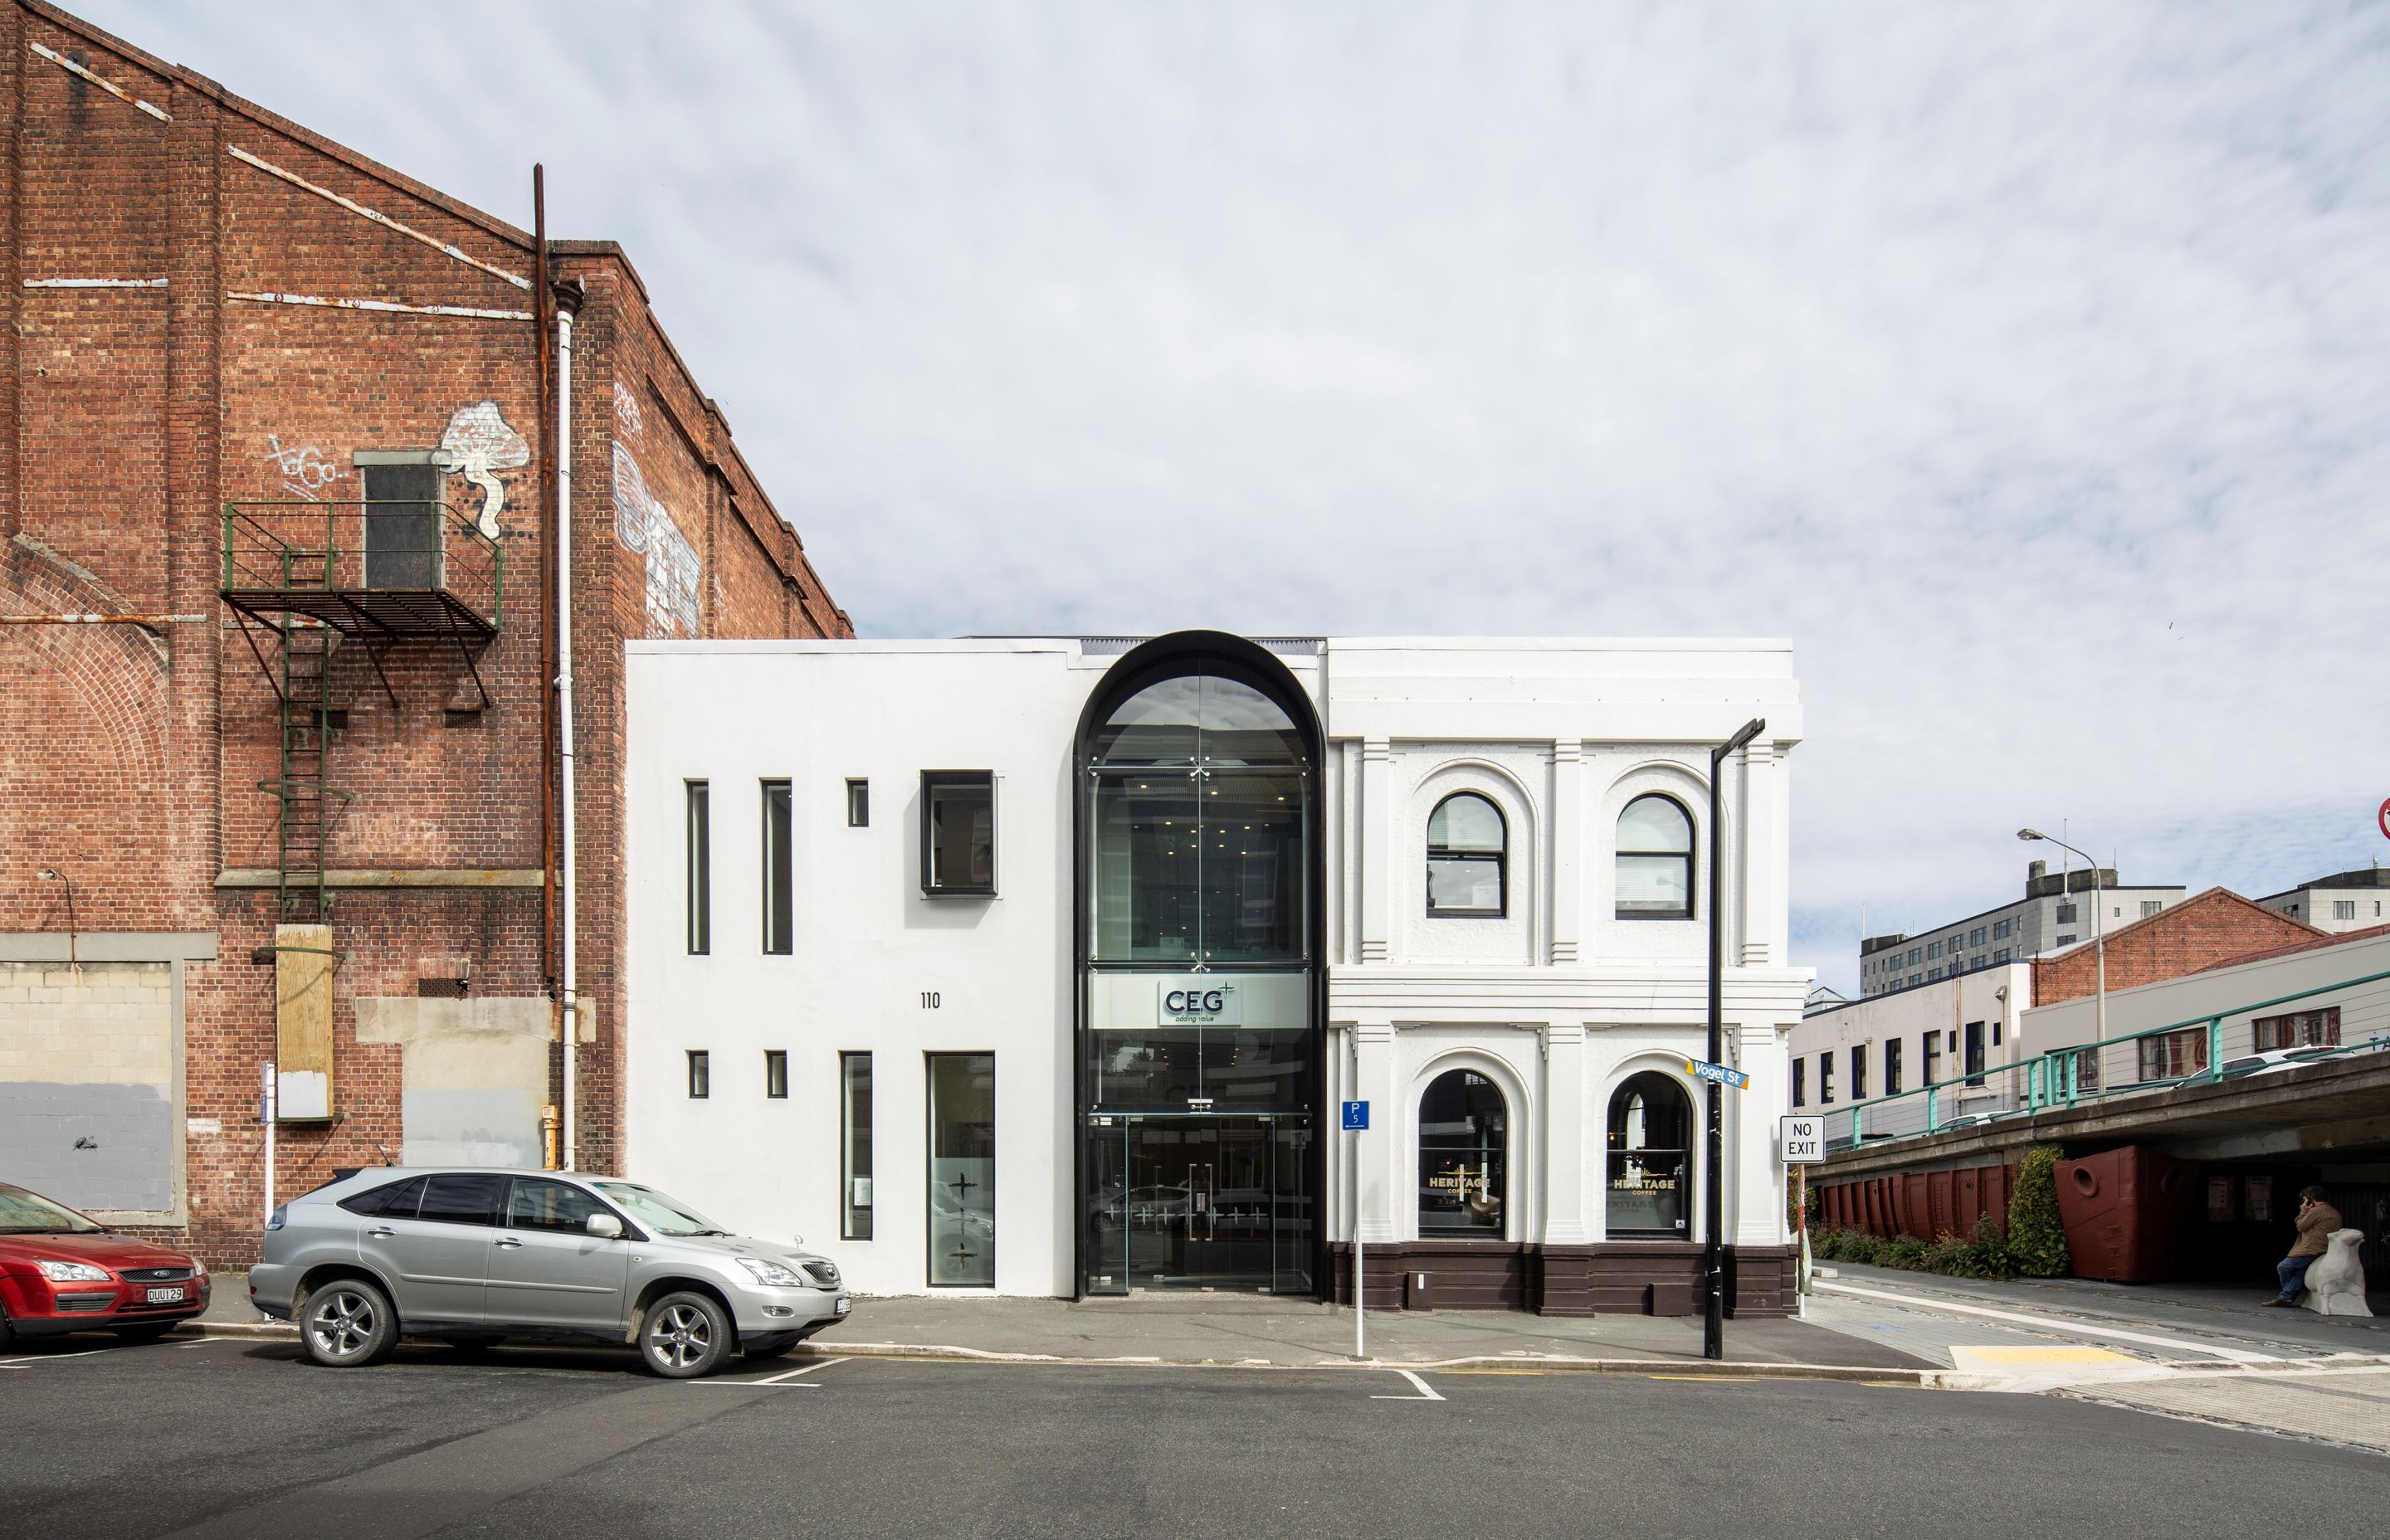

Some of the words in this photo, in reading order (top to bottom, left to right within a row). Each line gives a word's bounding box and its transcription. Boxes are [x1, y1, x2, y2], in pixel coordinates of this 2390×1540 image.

[921, 992, 940, 1009] 110
[1175, 1014, 1197, 1023] adding
[1198, 1014, 1214, 1022] value
[1695, 1061, 1724, 1080] Vogel
[1727, 1070, 1740, 1084] St
[1351, 1103, 1360, 1114] P
[1354, 1114, 1358, 1123] 5
[1793, 1123, 1812, 1136] NO
[1788, 1142, 1817, 1154] EXIT
[1613, 1179, 1675, 1189] HERITAGE
[149, 1289, 183, 1301] DUU129
